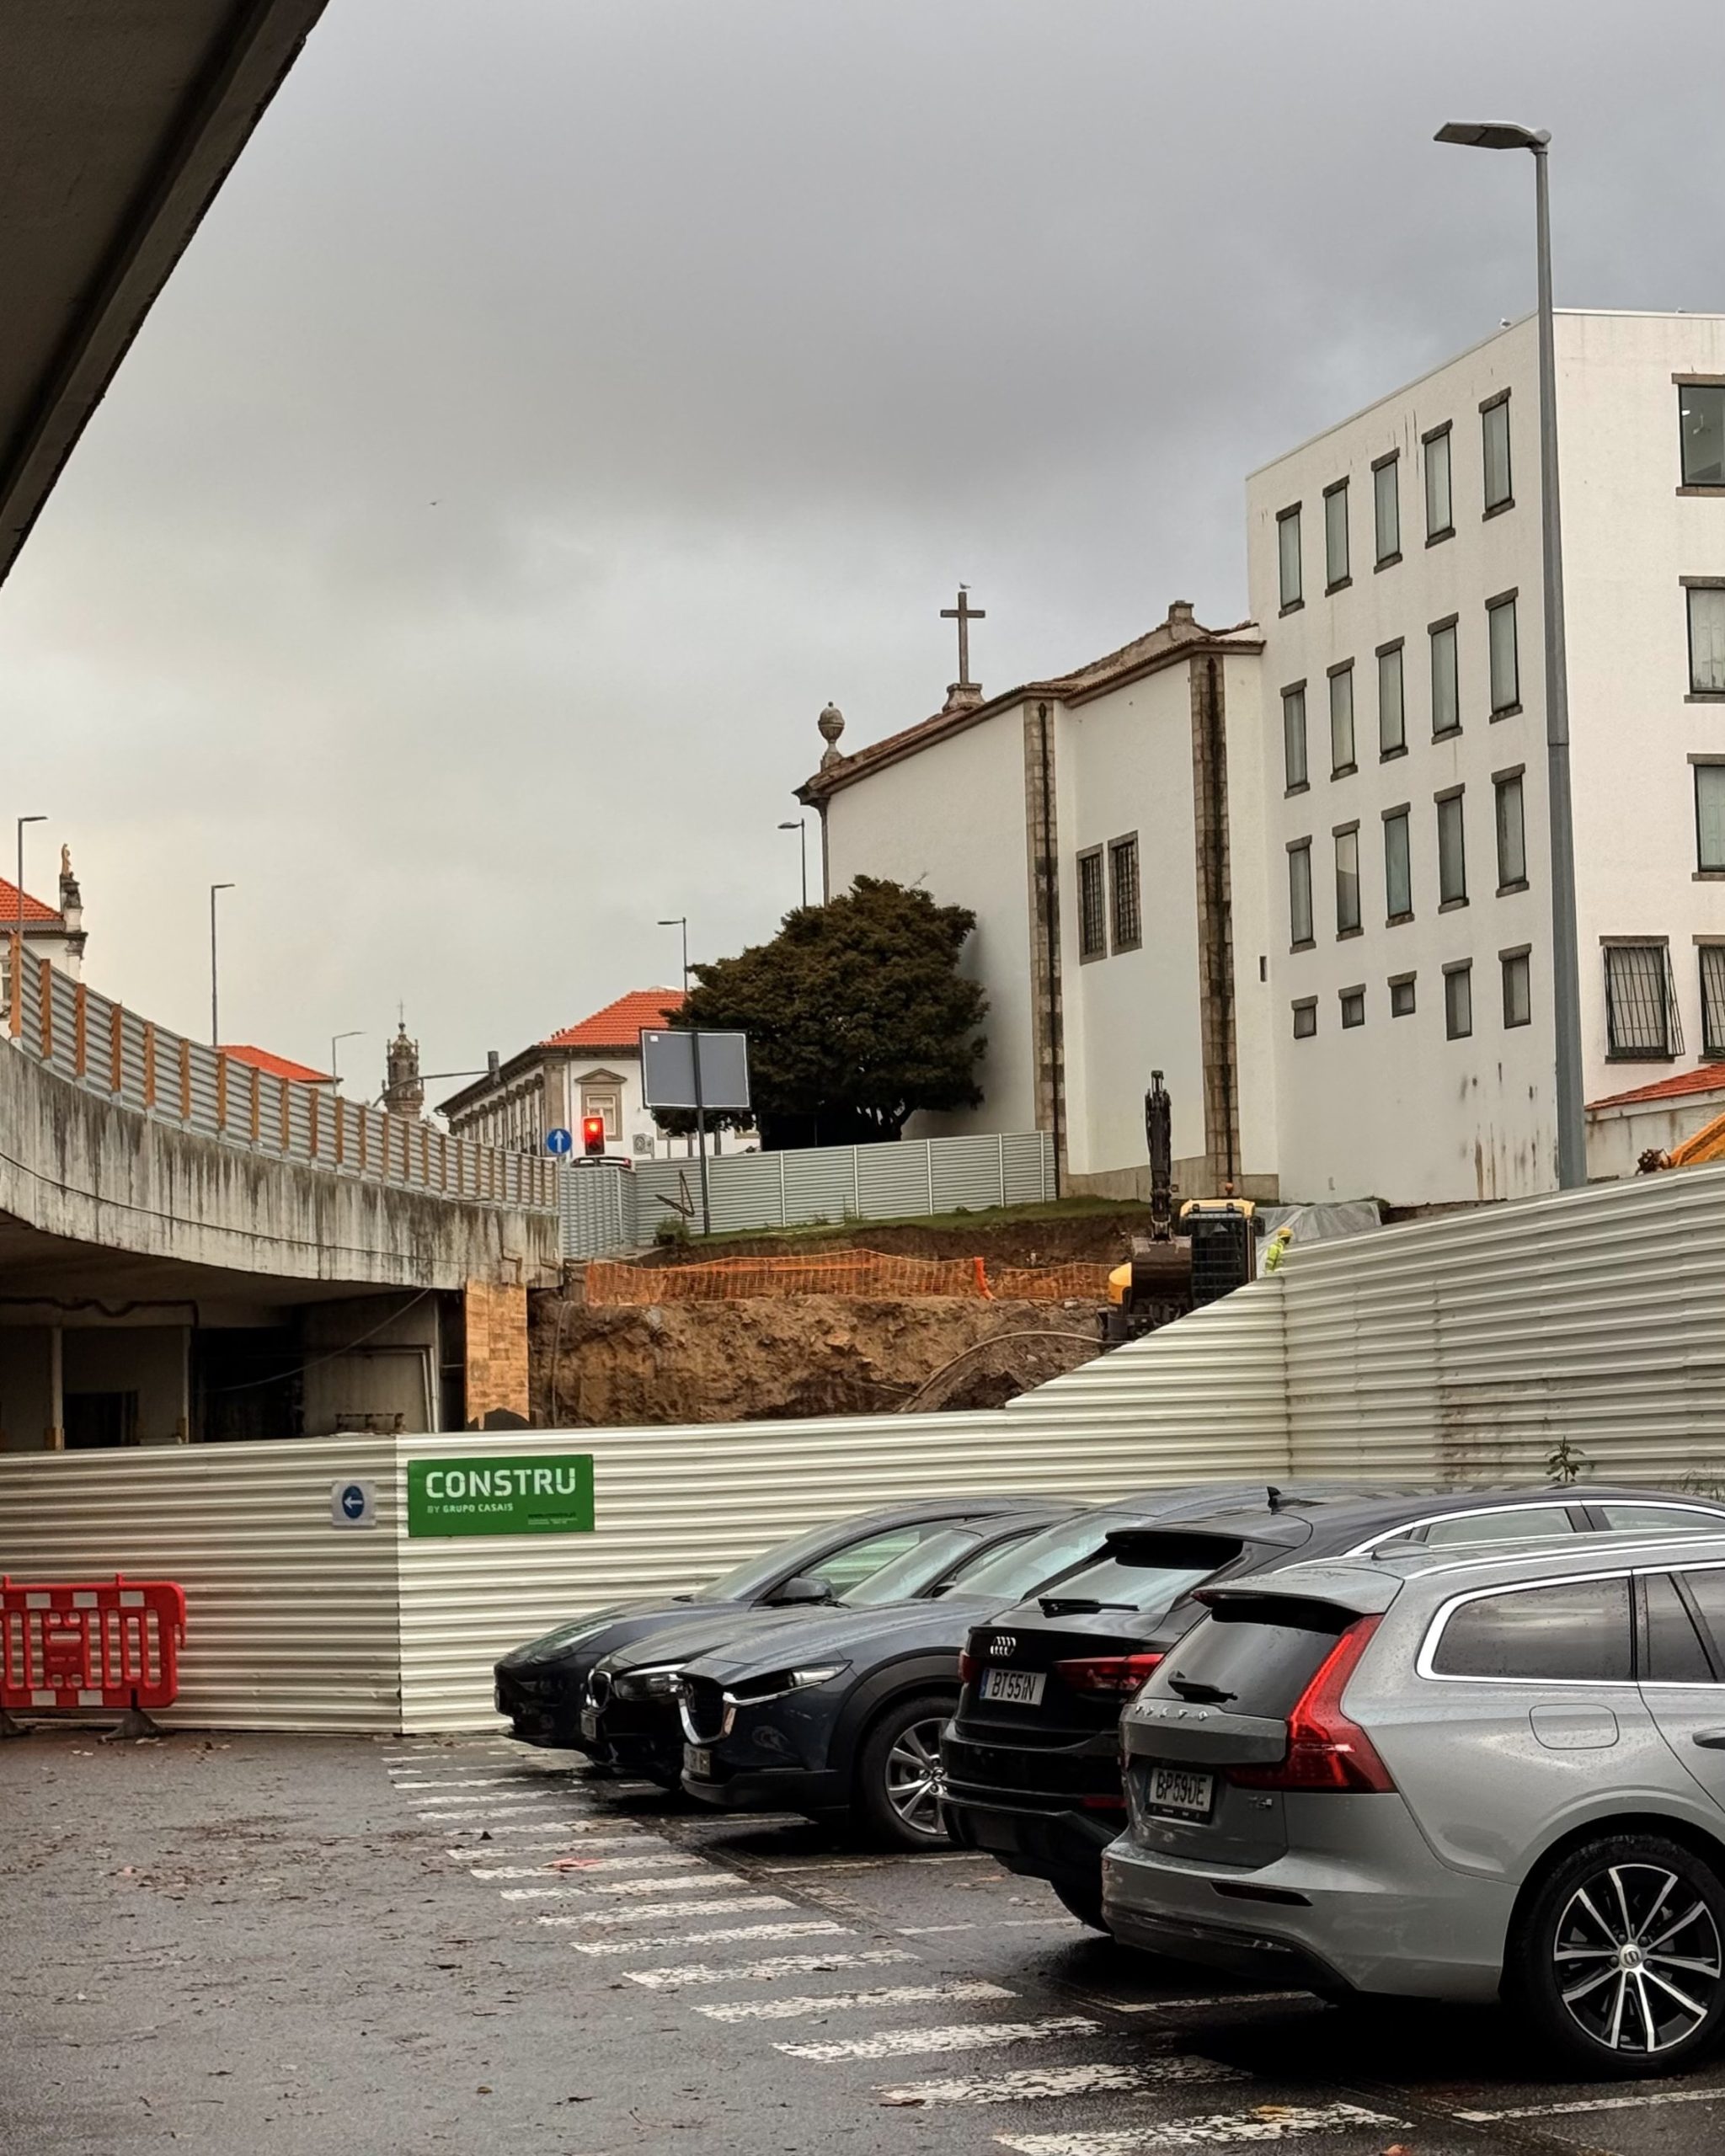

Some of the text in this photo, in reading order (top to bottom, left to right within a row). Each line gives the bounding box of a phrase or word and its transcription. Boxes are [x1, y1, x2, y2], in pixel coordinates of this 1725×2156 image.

[425, 1468, 576, 1498] CONSTRU
[427, 1502, 514, 1513] BY GRUPO CASAIS
